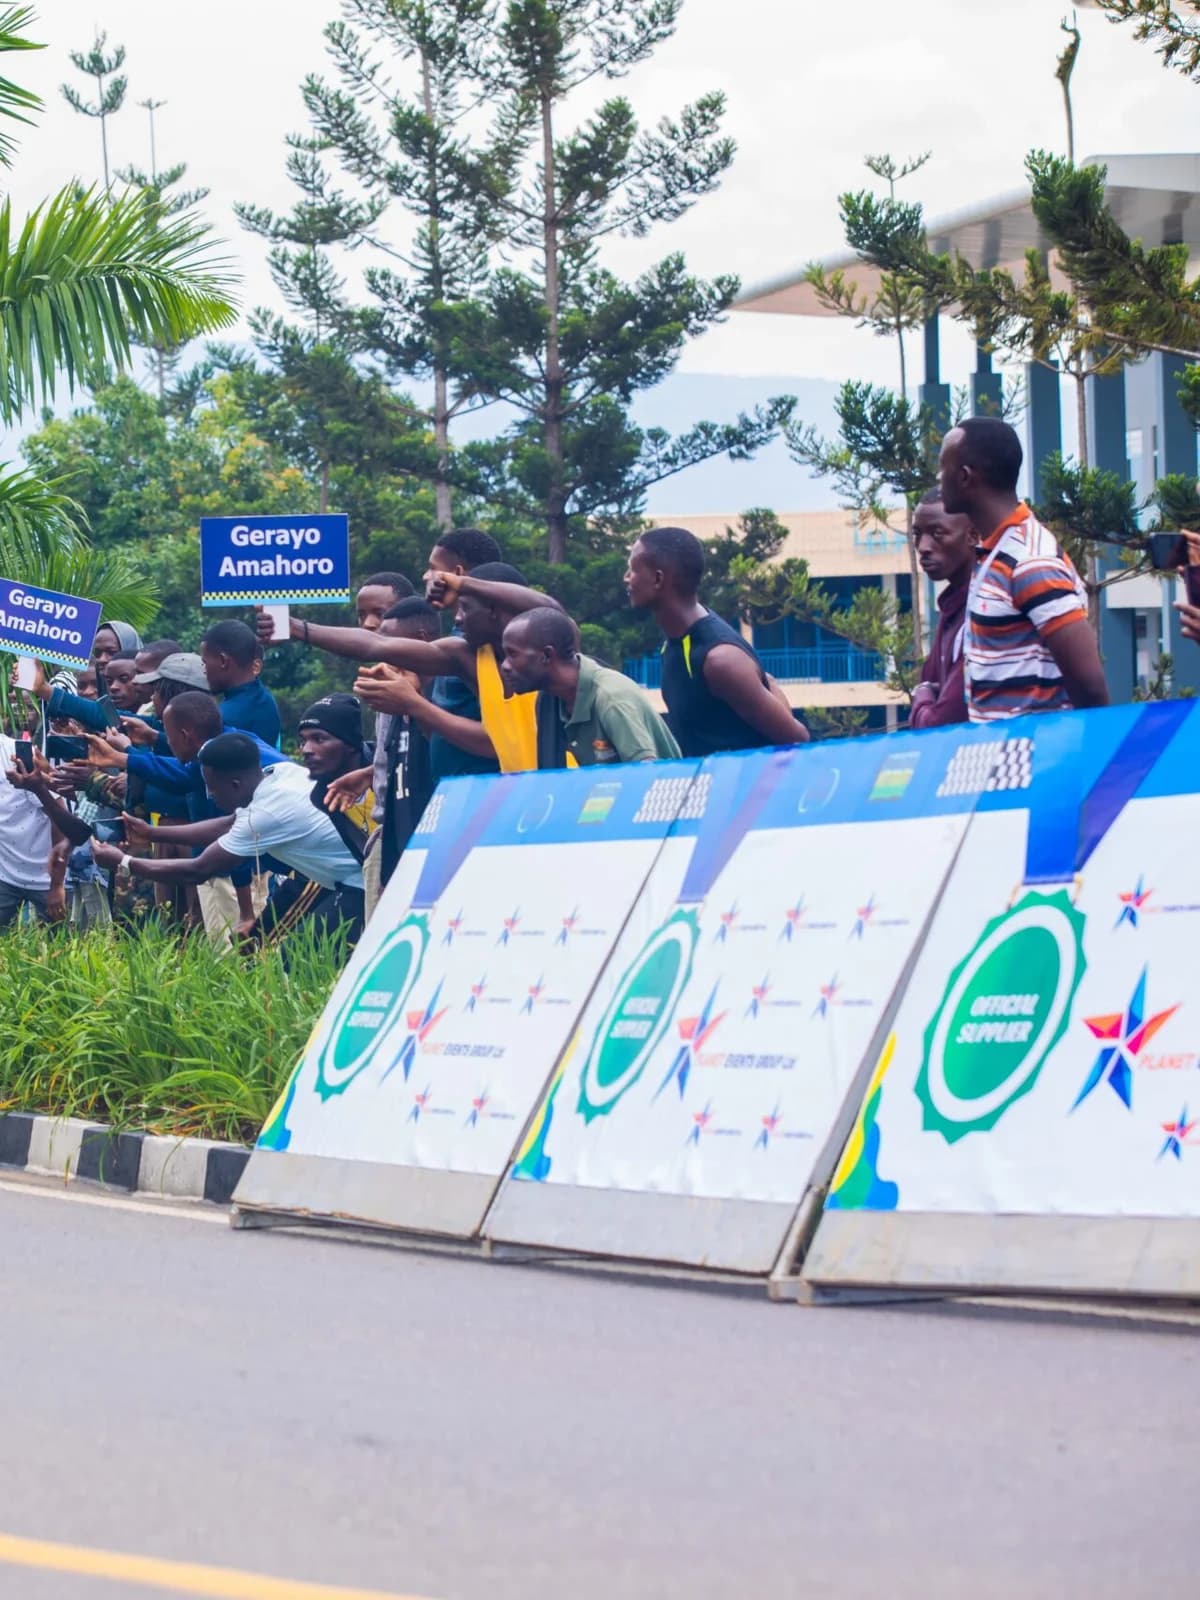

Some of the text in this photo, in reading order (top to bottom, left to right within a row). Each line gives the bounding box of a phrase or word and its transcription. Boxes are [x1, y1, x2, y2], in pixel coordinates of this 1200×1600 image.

[230, 524, 321, 550] Gerayo
[218, 554, 335, 577] Amahoro
[8, 588, 79, 620] Gerayo
[1138, 1053, 1196, 1071] PLANET
